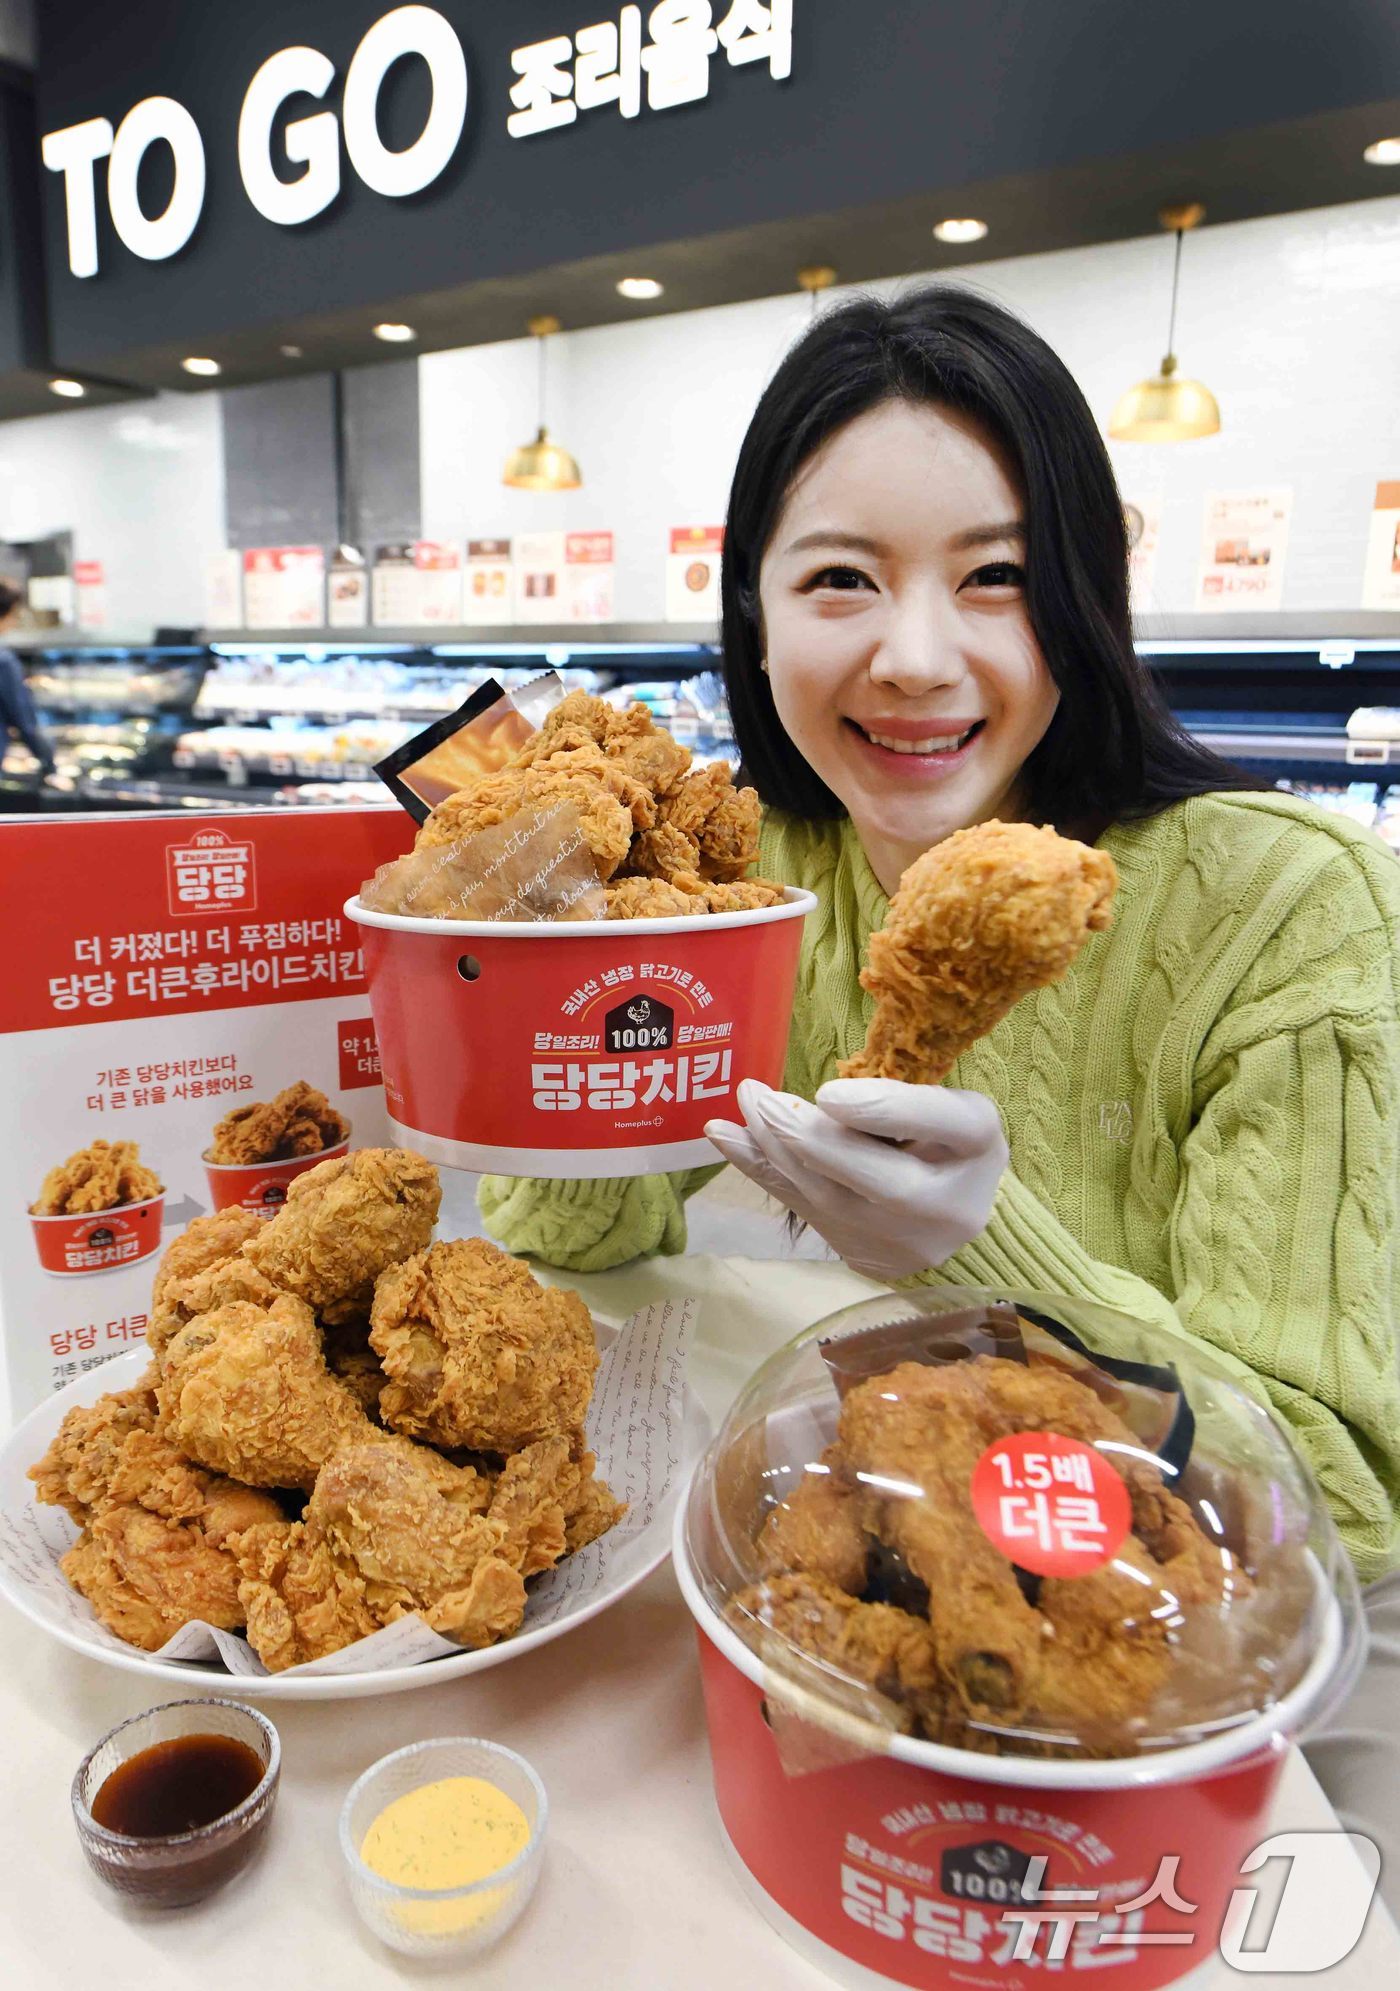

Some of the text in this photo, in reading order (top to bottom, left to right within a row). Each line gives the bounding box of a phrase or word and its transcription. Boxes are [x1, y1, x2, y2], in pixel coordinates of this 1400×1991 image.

[507, 0, 794, 139] 조리음식
[42, 4, 469, 278] TO GO
[176, 864, 248, 902] 당당
[75, 918, 342, 965] 더 커졌다! 더 푸짐하다!
[49, 949, 365, 1011] 당당 더큰후라이드치킨
[560, 963, 714, 1016] 국내산 냉장 닭고기로 만든
[342, 1037, 360, 1056] 약
[534, 1032, 600, 1050] 당일조리!
[611, 1026, 668, 1050] 100%
[676, 1022, 732, 1044] 당일판매!
[96, 1054, 237, 1087] 기존 당당치킨보다
[531, 1049, 733, 1112] 당당치킨
[87, 1073, 254, 1113] 더 큰 닭을 사용했어요
[614, 1119, 652, 1129] Homeplus
[50, 1313, 148, 1356] 당당 더큰
[52, 1361, 77, 1377] 기존
[991, 1452, 1095, 1494] 1.5배
[999, 1492, 1108, 1554] 더큰
[840, 1862, 1146, 1972] 당당치킨
